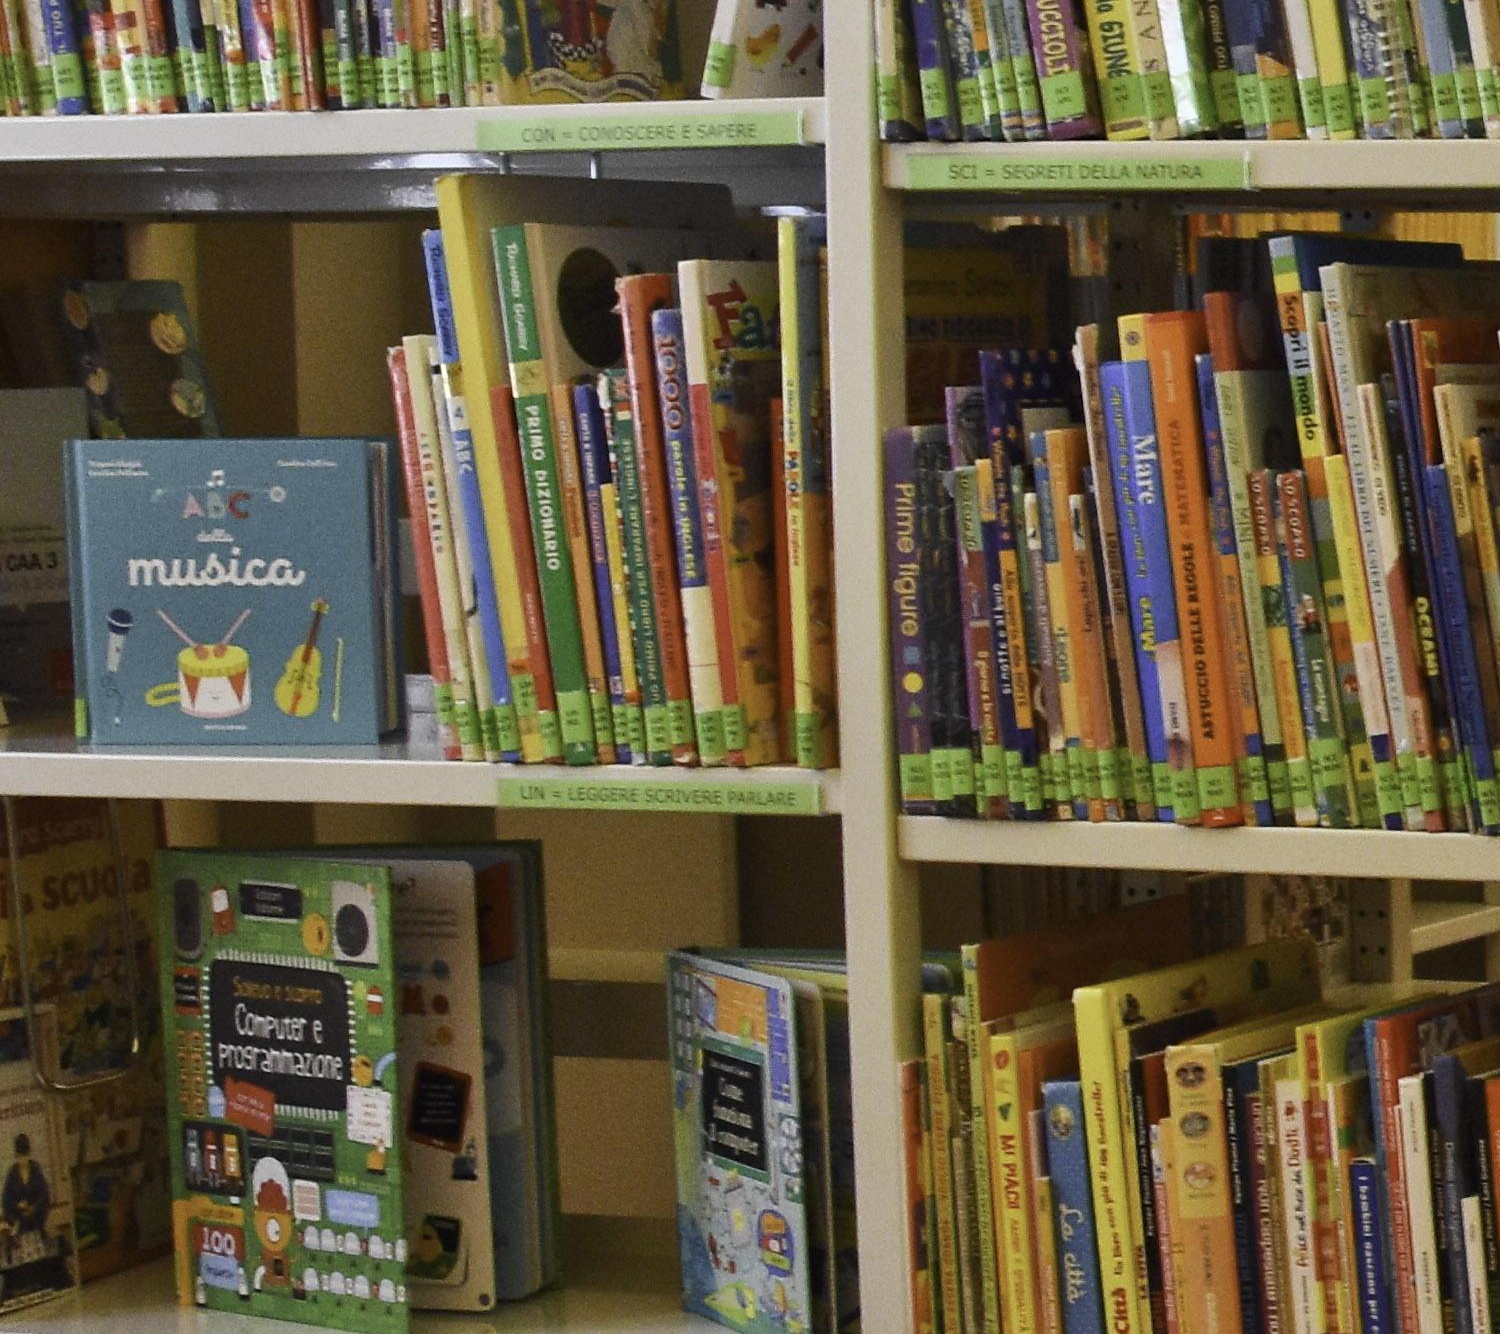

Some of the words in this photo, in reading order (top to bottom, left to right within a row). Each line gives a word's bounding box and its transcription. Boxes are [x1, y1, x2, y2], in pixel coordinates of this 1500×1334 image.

[1100, 20, 1132, 78] GIUNG
[522, 127, 556, 143] CON
[579, 124, 675, 142] CONOSCERE
[697, 123, 757, 139] SAPERE
[949, 164, 978, 180] SCI
[1003, 164, 1073, 180] SEGRETI
[1080, 164, 1130, 180] DELLA
[1136, 164, 1203, 180] NATURA
[656, 336, 683, 431] 1000
[1280, 294, 1309, 353] Scopri
[1297, 375, 1318, 441] mondo
[525, 405, 547, 461] PRIMO
[667, 440, 687, 492] parole
[1132, 433, 1158, 504] Mare
[182, 489, 251, 519] ABC
[534, 469, 562, 571] DIZIONARIO
[894, 482, 917, 553] Prime
[127, 545, 306, 587] musica
[681, 514, 697, 580] INGLESE
[893, 561, 921, 637] figure
[1414, 595, 1438, 677] OCEANI
[520, 785, 545, 800] LIN
[568, 786, 639, 803] LEGGERE
[645, 788, 722, 805] SCRIVERE
[727, 789, 796, 806] PARLARE
[42, 858, 152, 911] scuoa
[234, 1002, 310, 1042] Computer
[217, 1040, 343, 1082] programmazione
[1060, 1202, 1083, 1240] La
[1358, 1184, 1377, 1239] bambini
[201, 1225, 236, 1255] 100
[1062, 1252, 1084, 1304] città
[1362, 1241, 1377, 1296] nascono
